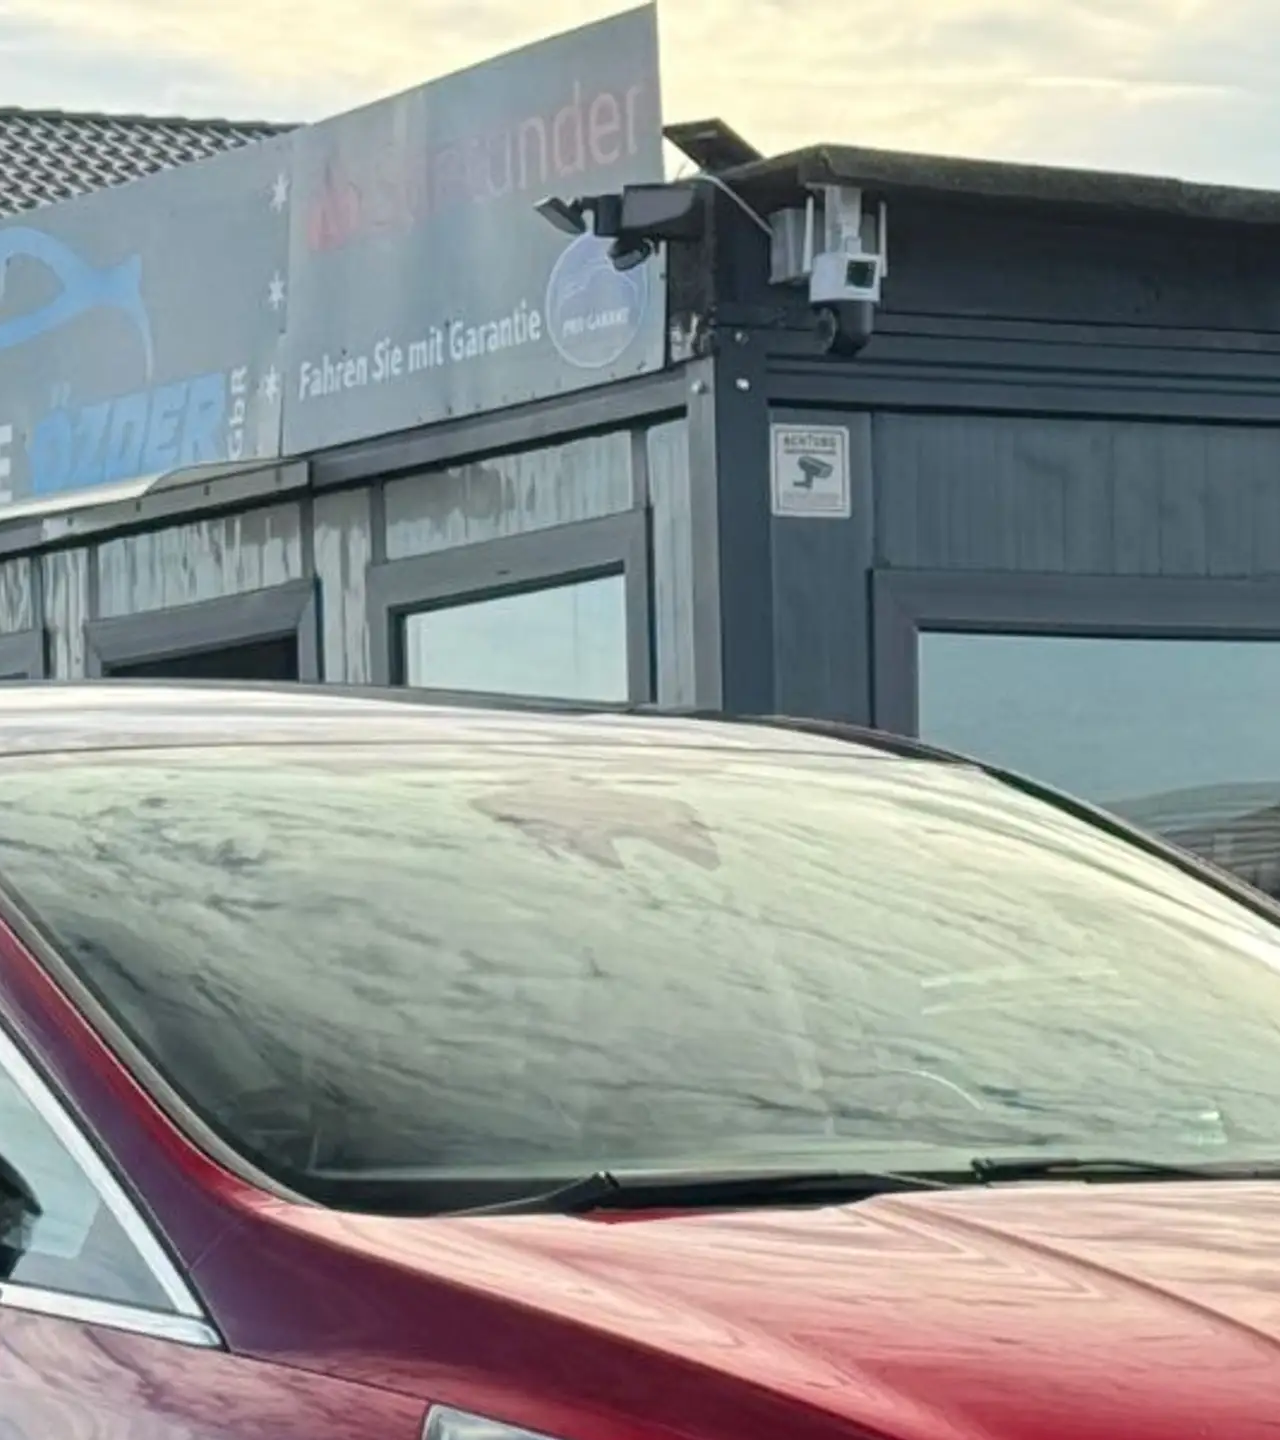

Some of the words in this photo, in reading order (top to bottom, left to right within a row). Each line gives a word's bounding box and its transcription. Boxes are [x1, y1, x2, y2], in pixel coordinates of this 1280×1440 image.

[298, 350, 369, 402] Fahren
[372, 332, 402, 381] Sie
[407, 329, 445, 371] mit
[448, 299, 542, 358] Garantie
[29, 372, 226, 494] ÖZDER
[228, 365, 248, 459] GbR
[784, 434, 837, 447] ACHTUNG
